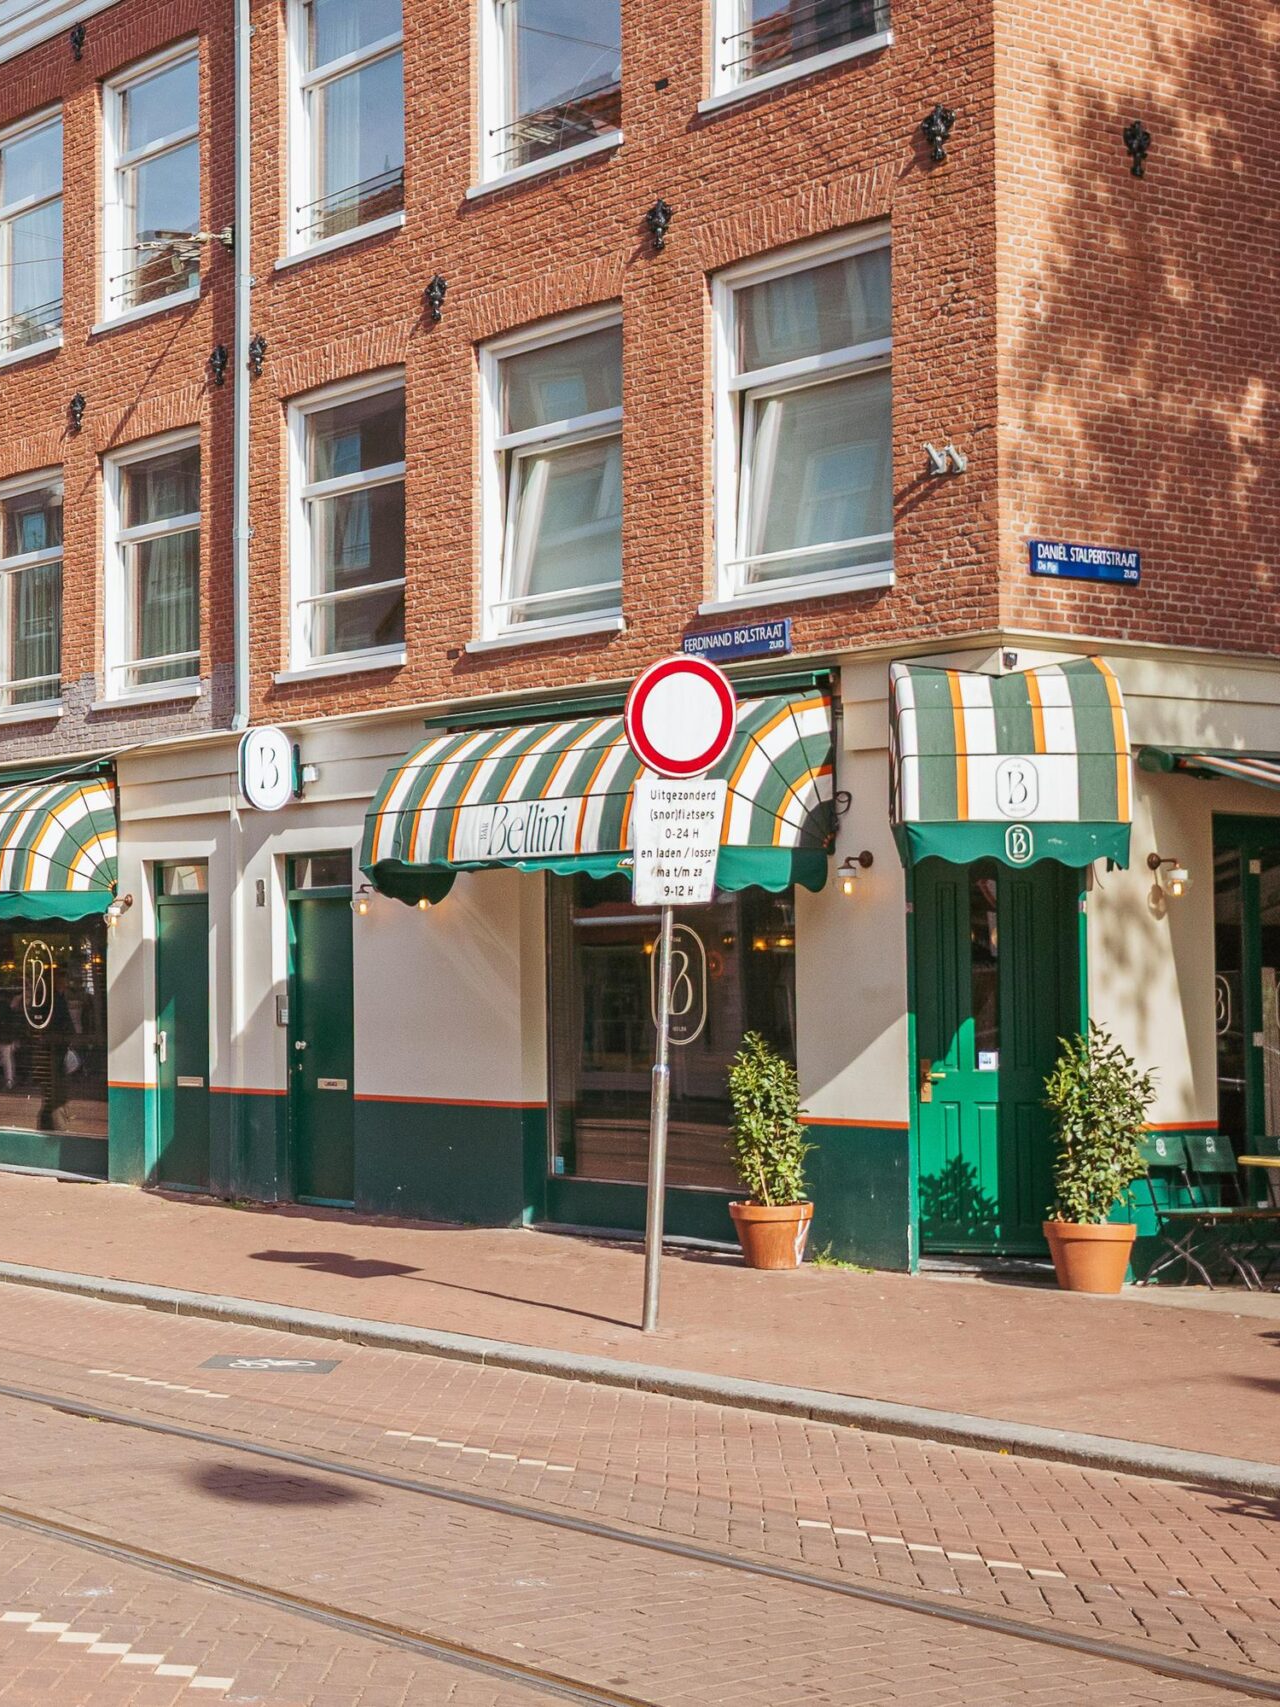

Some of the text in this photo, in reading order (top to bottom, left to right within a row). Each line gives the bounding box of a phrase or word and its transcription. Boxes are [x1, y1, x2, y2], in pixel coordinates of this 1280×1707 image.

[1037, 543, 1137, 568] DANIËL STALPERTSTRAAT
[1123, 569, 1138, 579] ZUID
[684, 624, 784, 653] FERDINAND BOLSTRAAT
[768, 640, 785, 650] ZUID
[1008, 771, 1028, 804] B
[650, 790, 717, 803] Uitgezonderd
[650, 809, 715, 821] (snor)fietsers
[487, 804, 568, 855] Bellini
[665, 828, 699, 839] 0-24 H
[1012, 833, 1027, 854] B
[641, 850, 653, 858] en
[656, 848, 682, 858] laden
[656, 868, 670, 877] ma
[674, 866, 690, 878] t/m
[664, 886, 694, 896] 9-12 H
